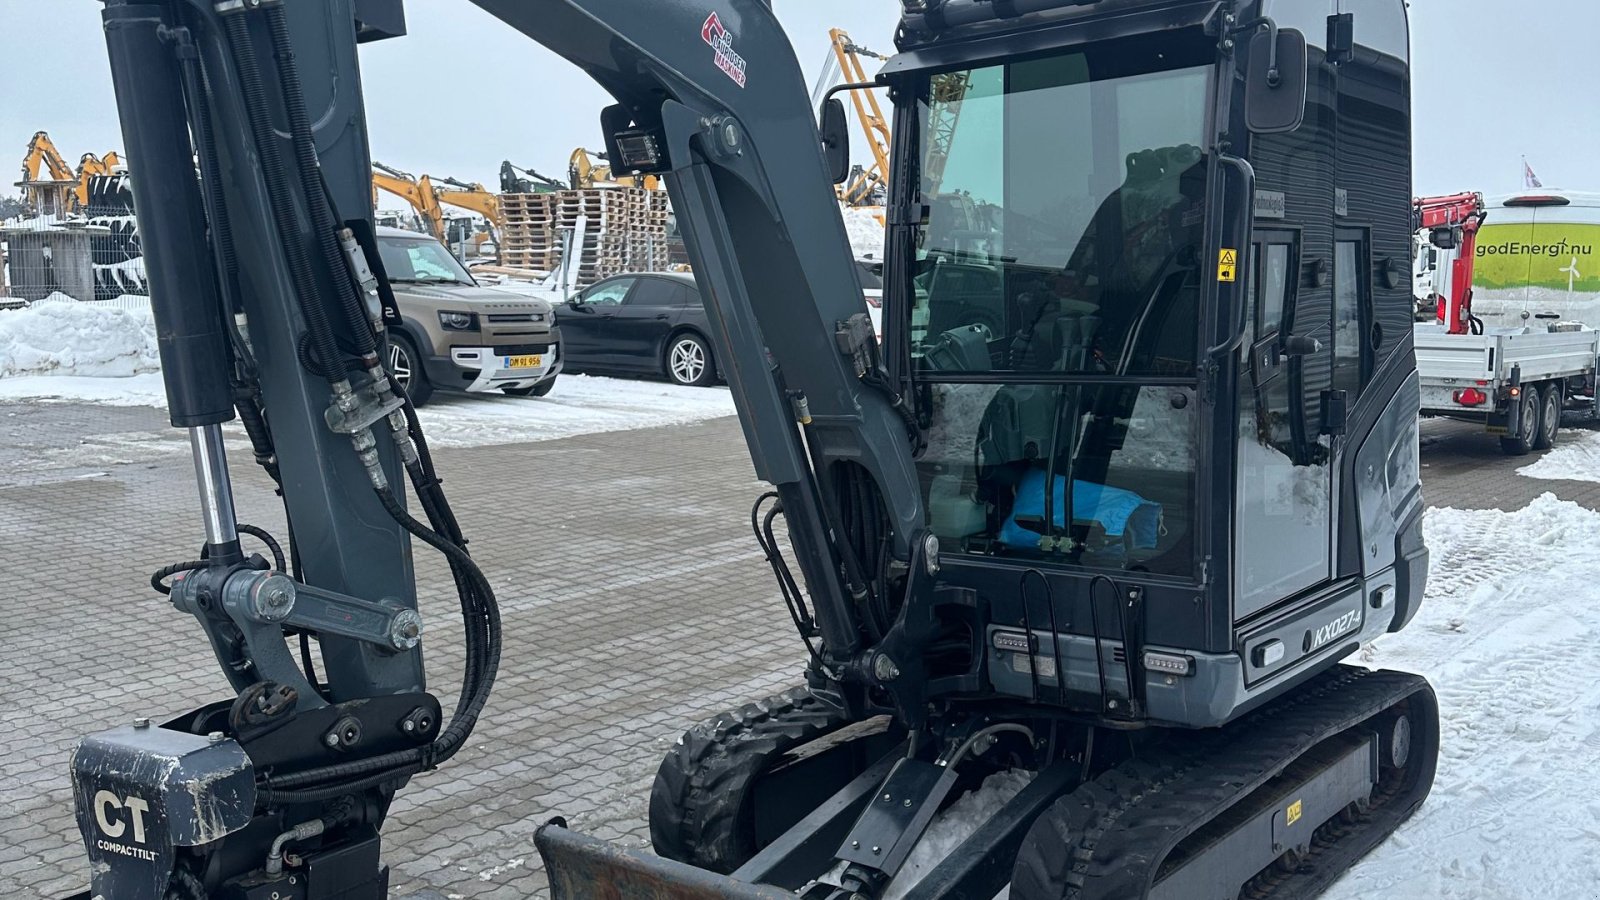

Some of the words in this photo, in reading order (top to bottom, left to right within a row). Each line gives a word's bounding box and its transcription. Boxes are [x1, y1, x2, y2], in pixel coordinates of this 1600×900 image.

[722, 30, 732, 47] AB
[714, 52, 746, 87] MASKINER
[1476, 238, 1592, 257] godEnergi.nu
[509, 358, 519, 367] DM
[520, 357, 527, 366] 91
[1313, 609, 1361, 648] KX027-4
[94, 789, 149, 844] CT
[97, 839, 156, 861] COMPACTTILT
